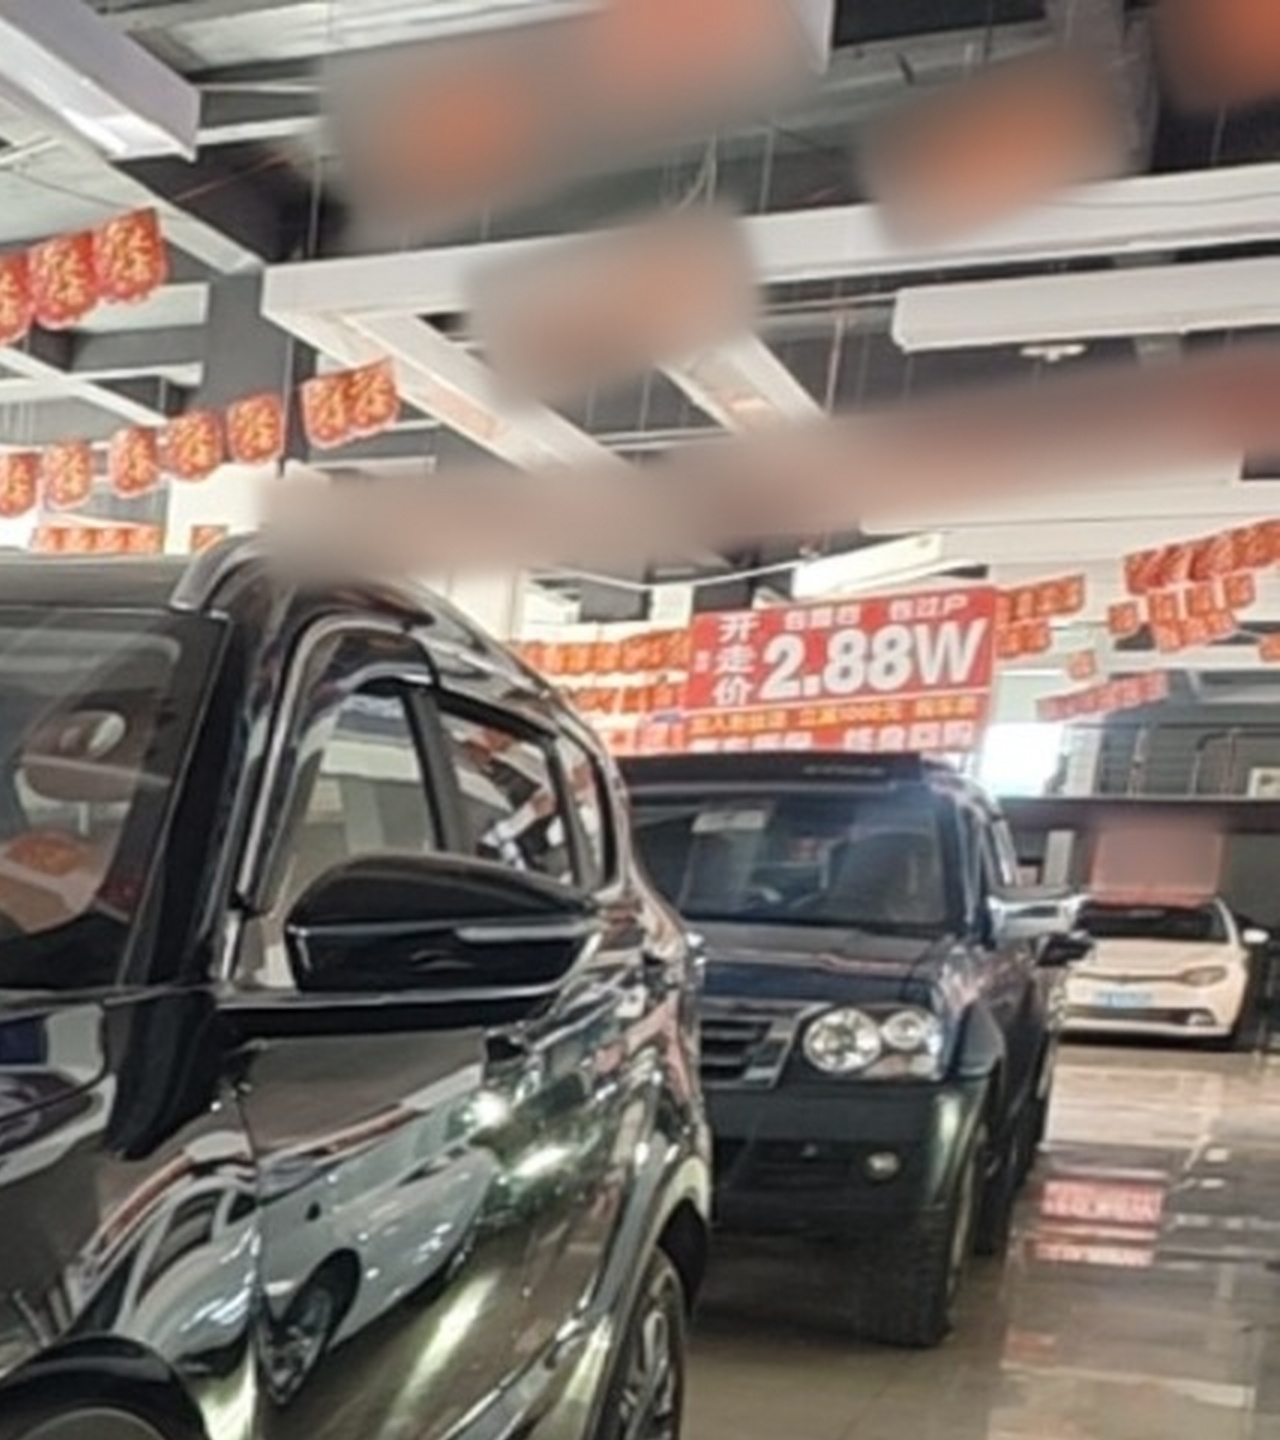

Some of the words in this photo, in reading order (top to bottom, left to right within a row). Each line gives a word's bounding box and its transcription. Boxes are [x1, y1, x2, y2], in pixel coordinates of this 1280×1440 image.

[712, 611, 759, 707] 开走价
[758, 616, 989, 701] 2.88W
